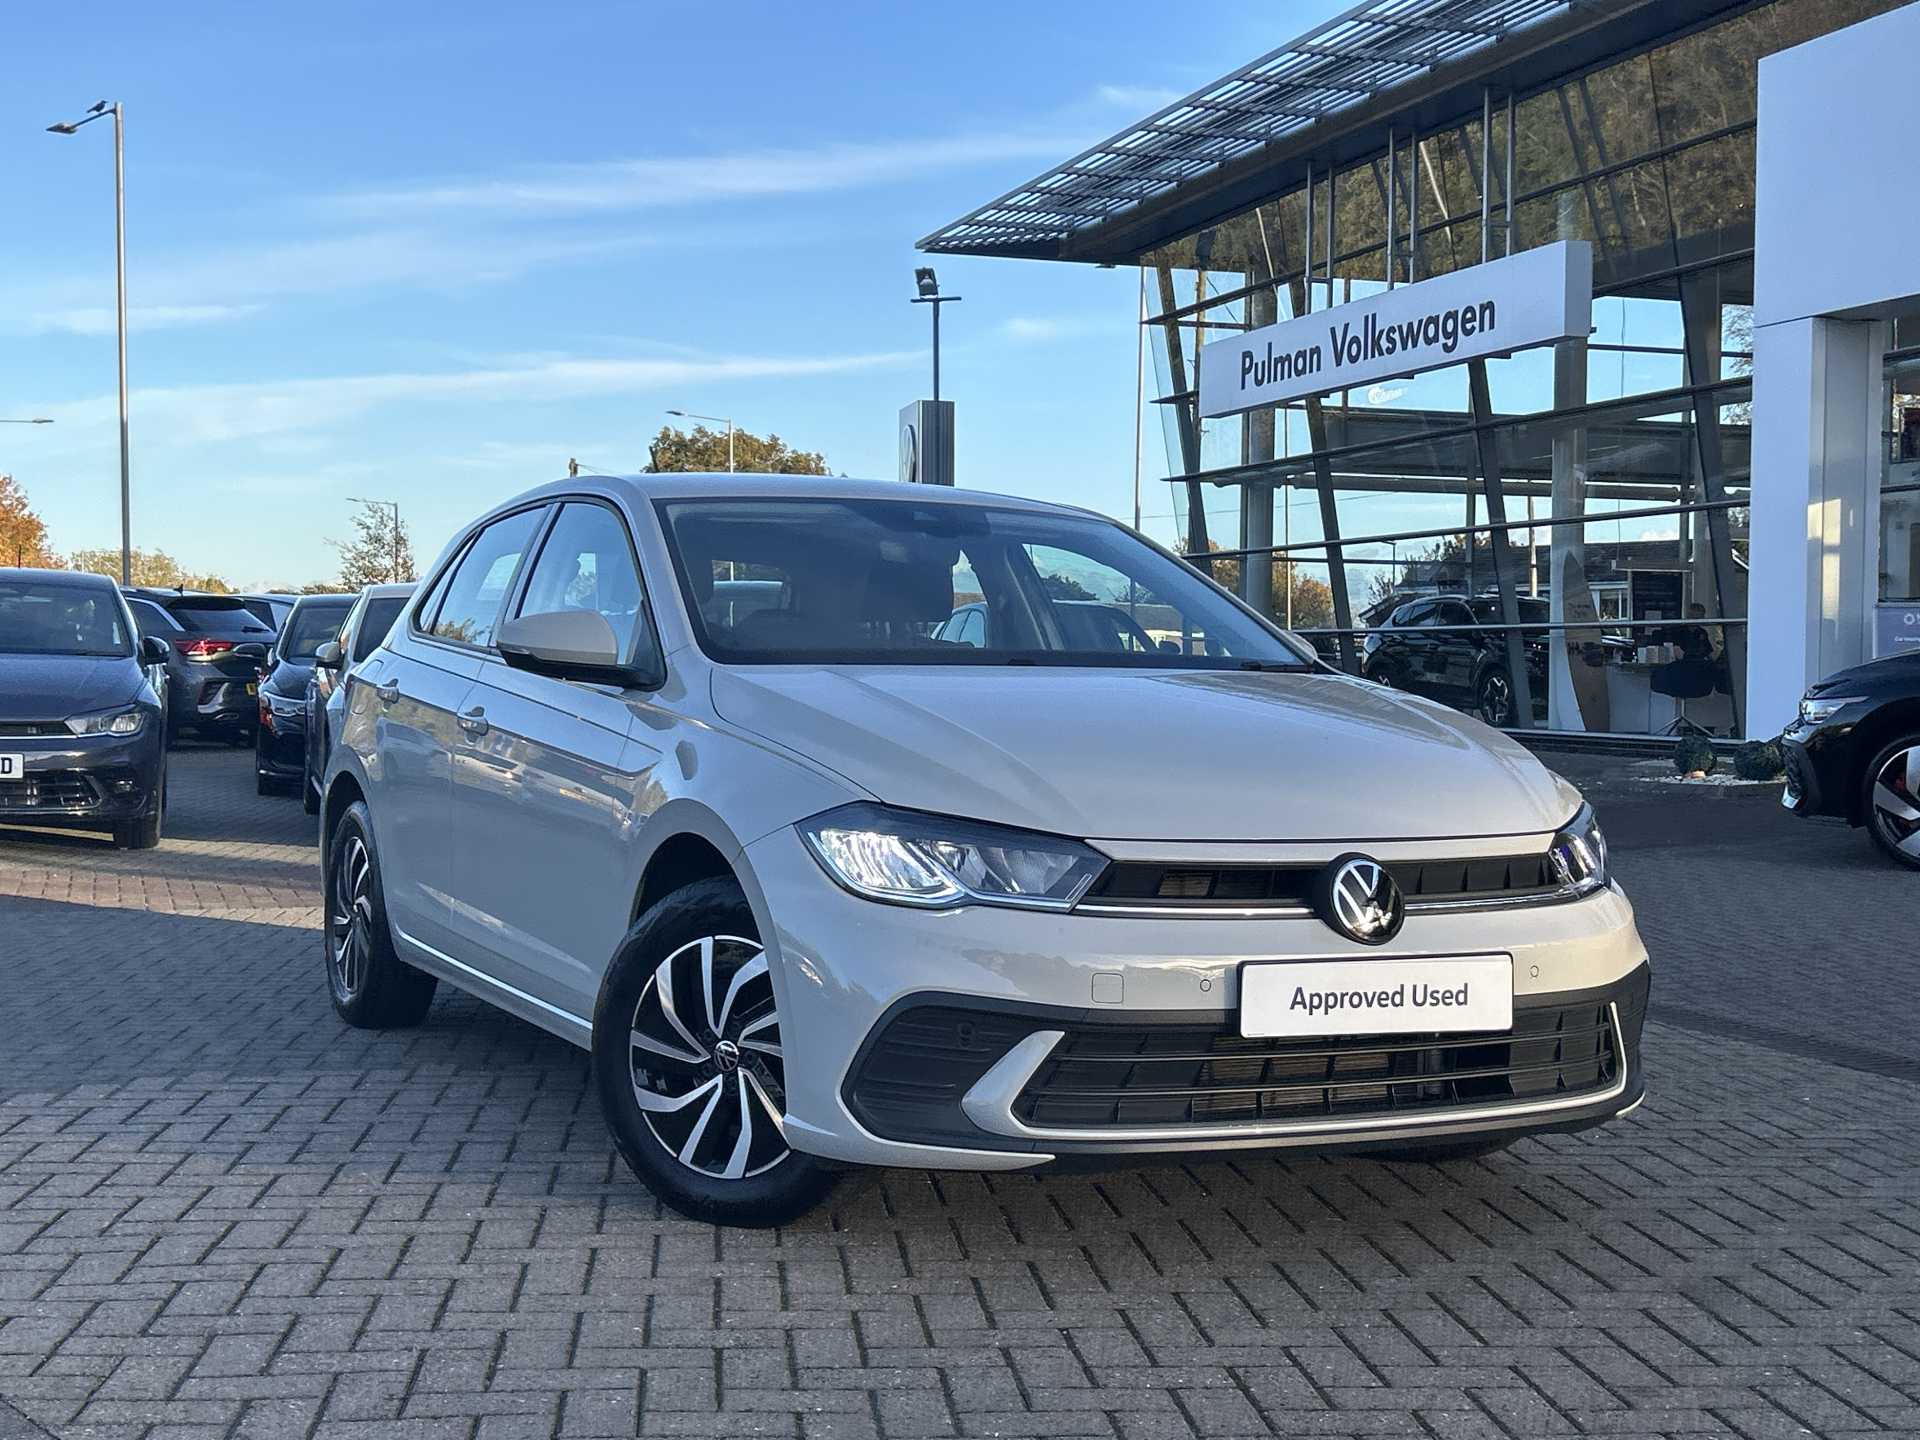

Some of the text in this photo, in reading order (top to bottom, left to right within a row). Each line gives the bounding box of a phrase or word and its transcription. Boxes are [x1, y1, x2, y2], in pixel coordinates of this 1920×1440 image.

[1240, 298, 1496, 390] Pulman Volkswagen
[1289, 982, 1469, 1015] Approved Used
